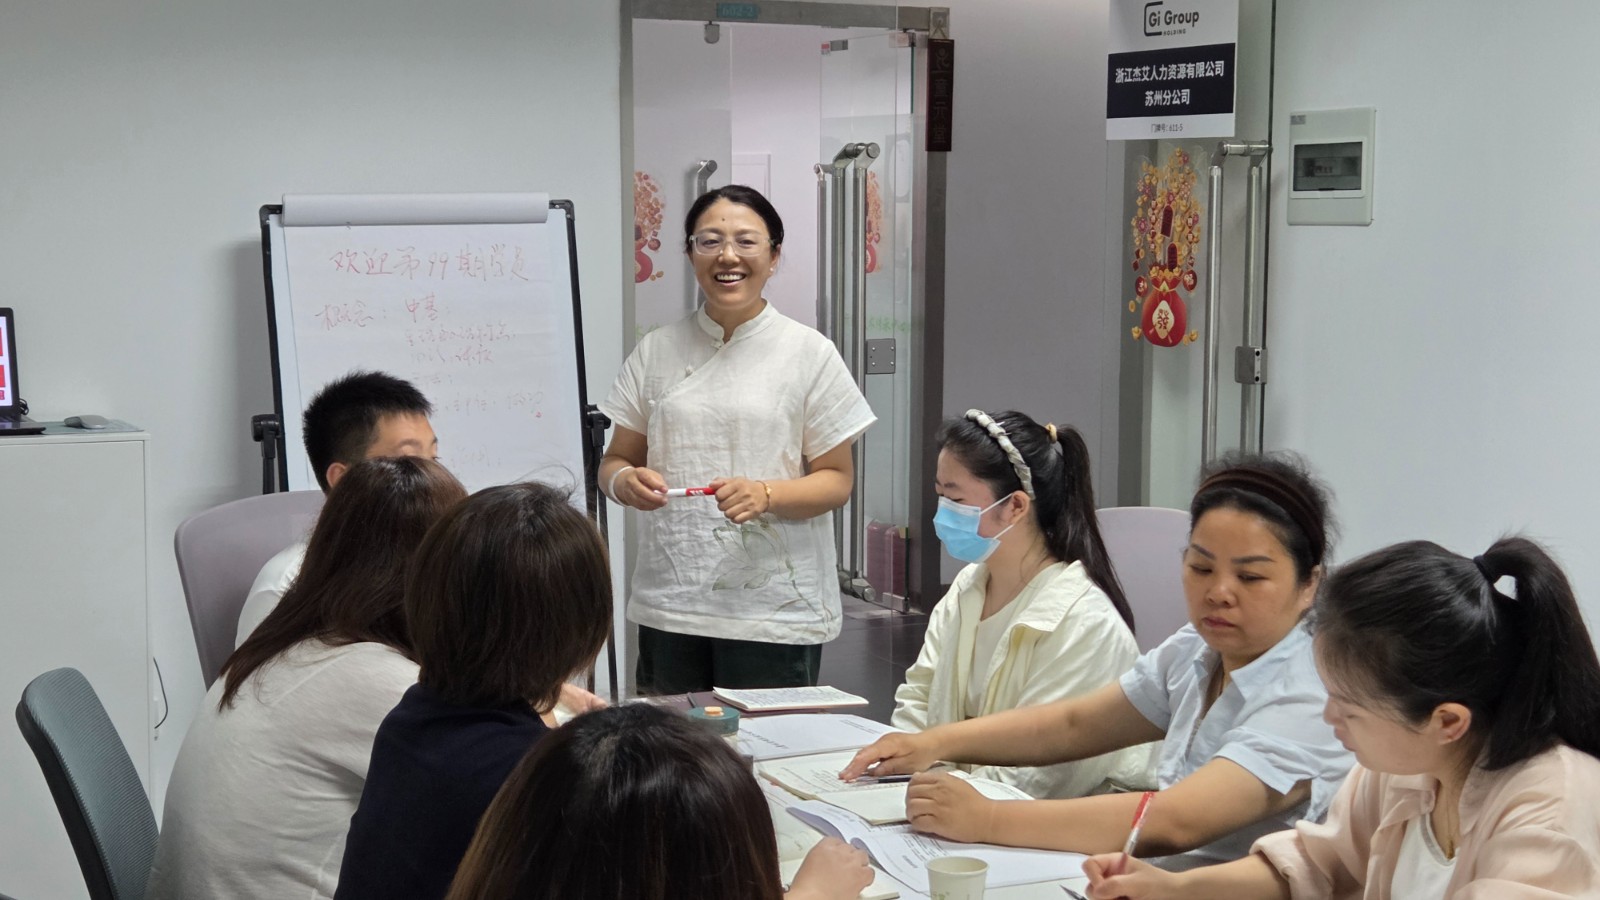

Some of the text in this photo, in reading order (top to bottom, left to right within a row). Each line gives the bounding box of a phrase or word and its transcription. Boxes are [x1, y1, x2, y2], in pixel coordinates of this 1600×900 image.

[1148, 10, 1200, 28] Gi Group
[1162, 28, 1187, 37] HOLDING
[1114, 60, 1225, 83] 浙江杰艾人力资源有限公司
[1144, 88, 1191, 107] 苏州分公司
